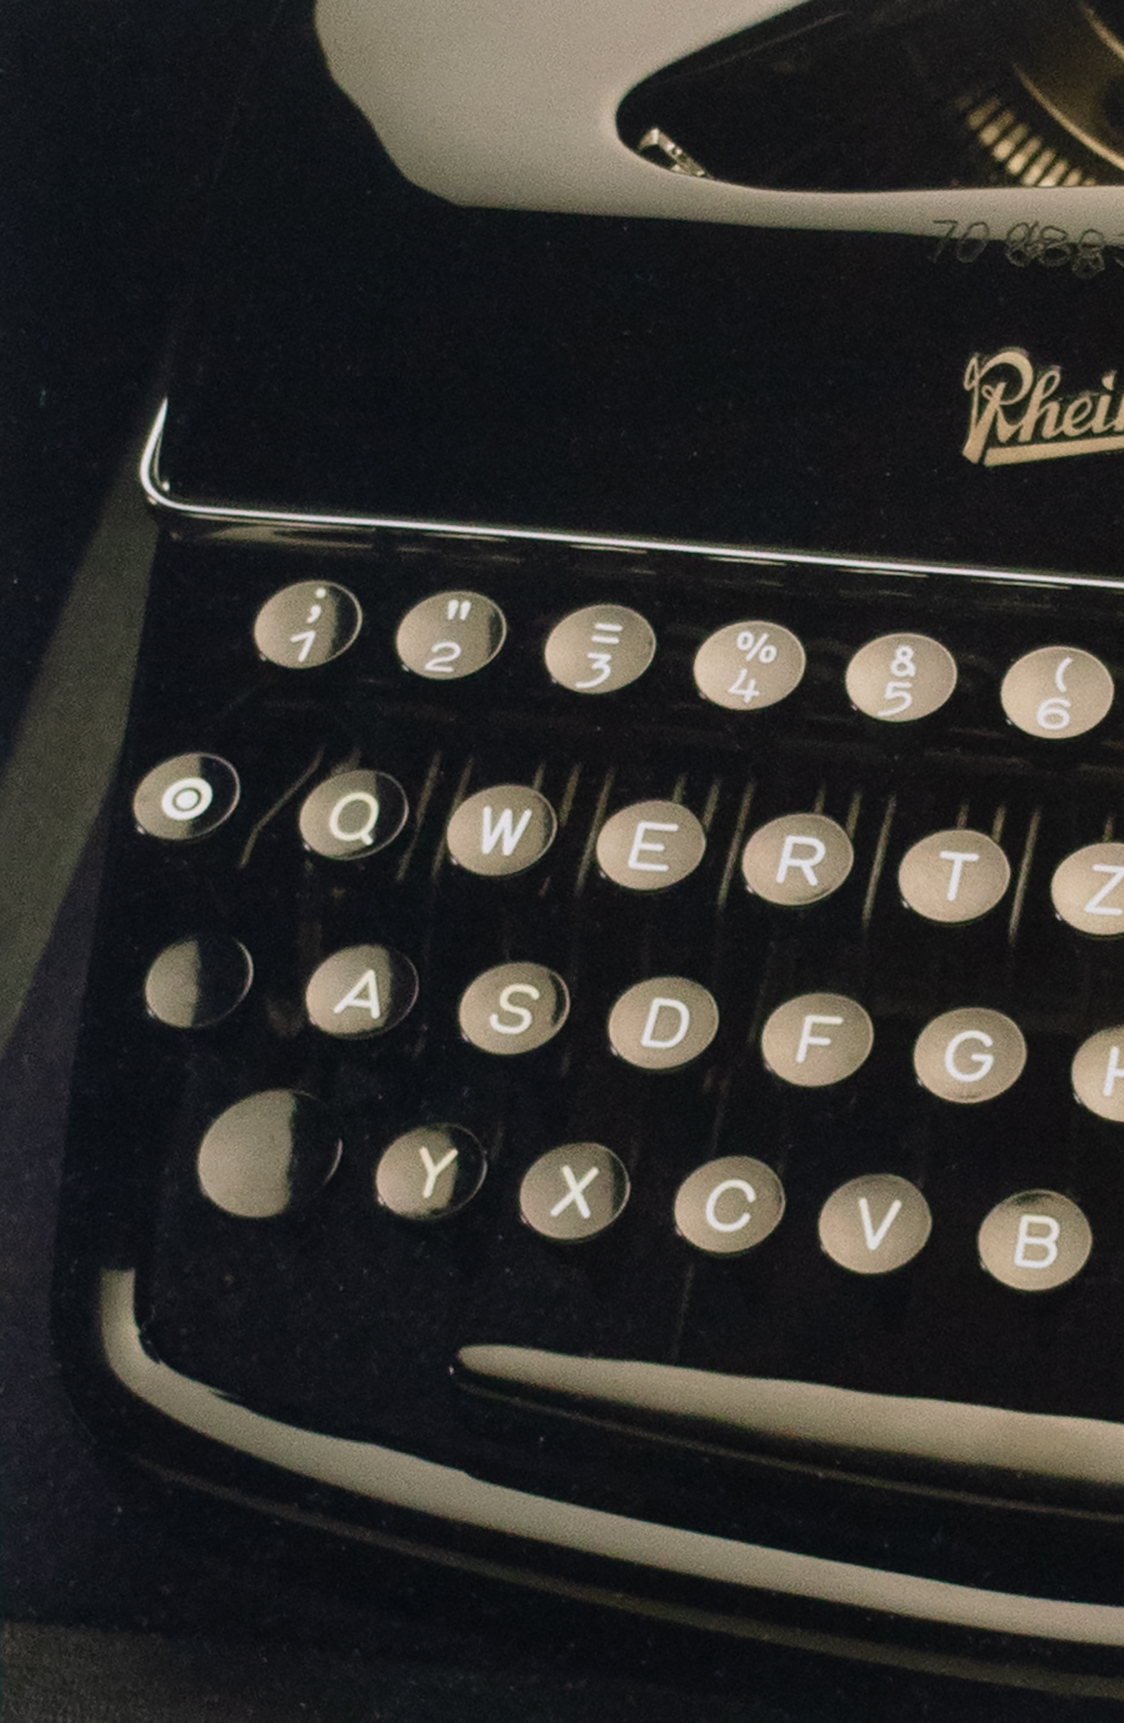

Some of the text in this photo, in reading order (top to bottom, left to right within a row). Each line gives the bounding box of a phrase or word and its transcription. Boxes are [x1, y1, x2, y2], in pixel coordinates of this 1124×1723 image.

[289, 629, 317, 663] 1
[423, 640, 463, 674] 2
[574, 650, 613, 690] 3
[734, 629, 778, 665] %
[888, 644, 918, 679] &
[727, 667, 761, 705] 4
[876, 680, 914, 718] 5
[1034, 695, 1073, 732] 6
[327, 791, 379, 846] Q
[479, 805, 533, 857] W
[626, 819, 680, 873] E
[773, 833, 827, 887] R
[938, 849, 981, 903] T
[331, 969, 381, 1020] A
[488, 983, 540, 1035] S
[639, 996, 691, 1050] D
[794, 1013, 844, 1065] F
[942, 1029, 995, 1084] G
[419, 1146, 458, 1199] Y
[549, 1165, 599, 1219] X
[703, 1178, 757, 1233] C
[857, 1197, 902, 1252] V
[1012, 1214, 1061, 1270] B
